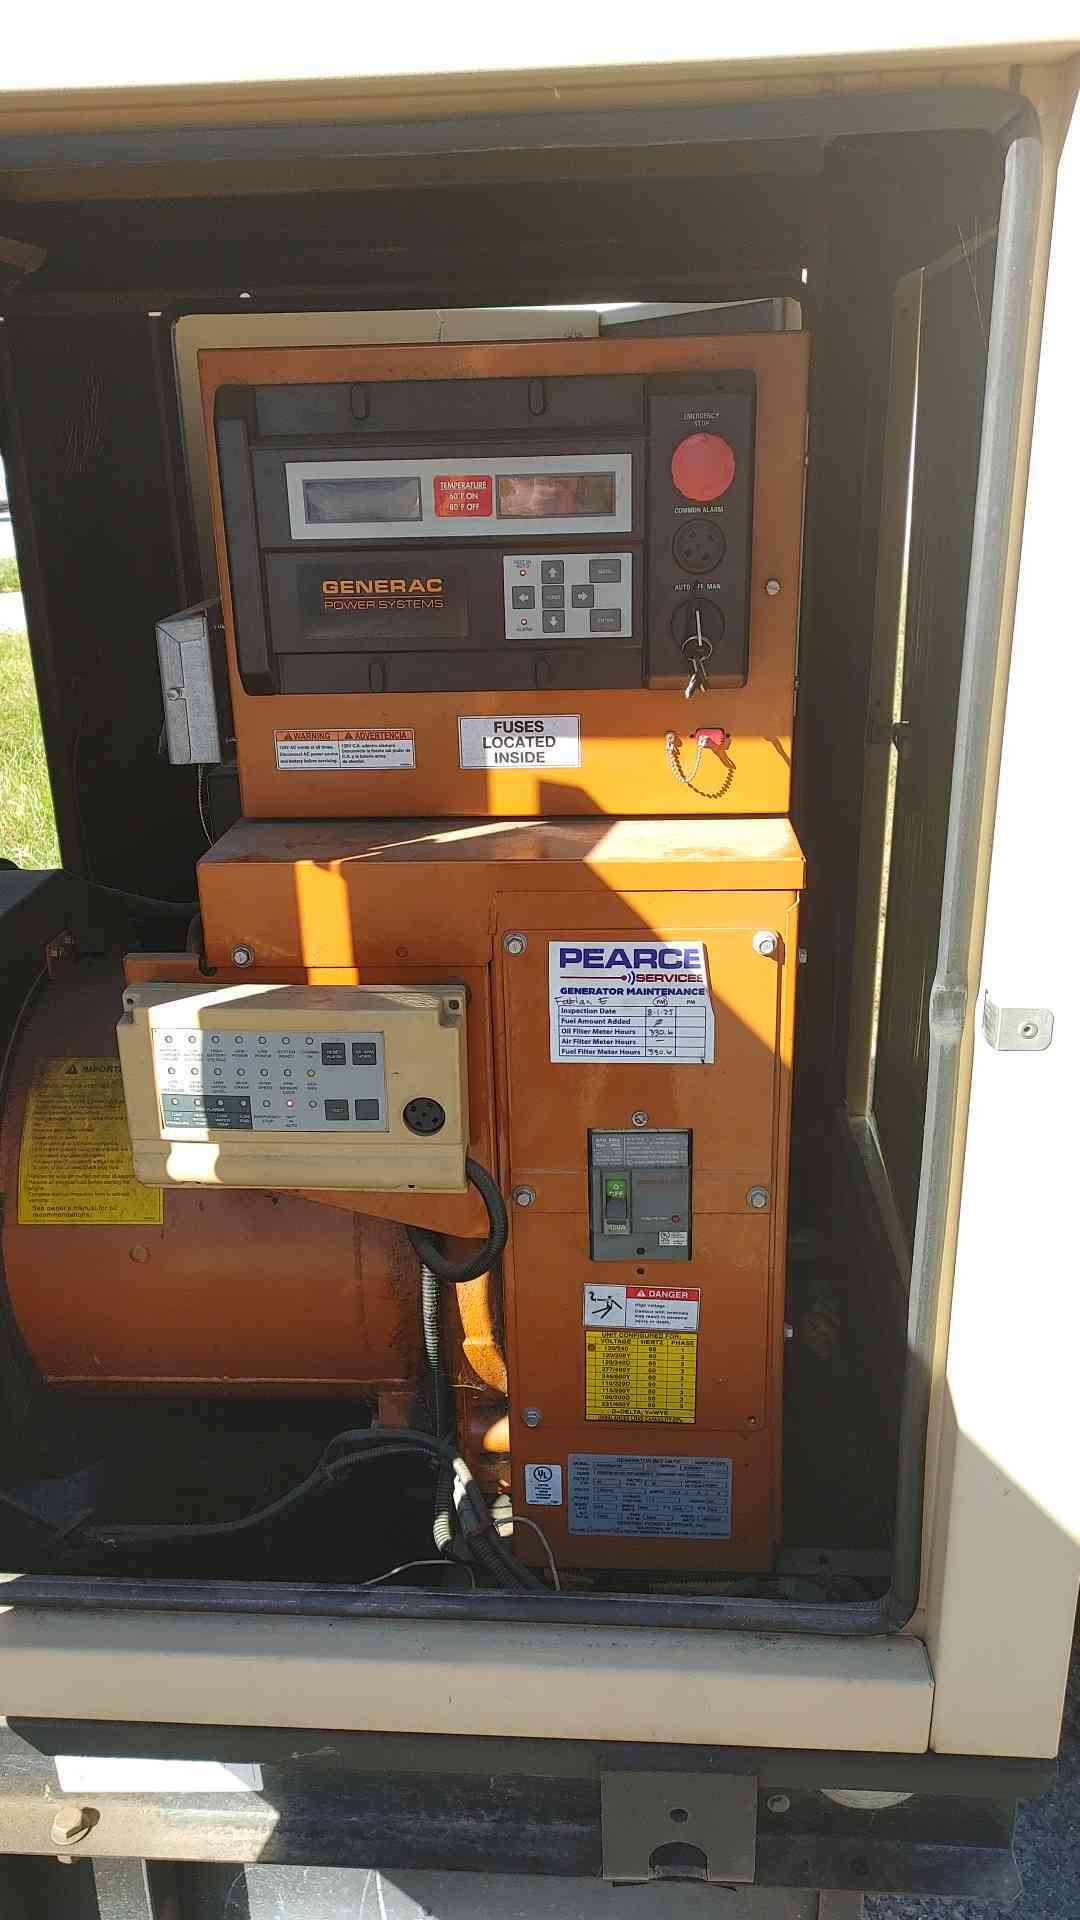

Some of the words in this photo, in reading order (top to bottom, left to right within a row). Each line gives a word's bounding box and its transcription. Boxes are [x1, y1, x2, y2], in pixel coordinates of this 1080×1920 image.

[440, 481, 487, 489] TEMPERATURE
[466, 492, 479, 500] ON
[703, 505, 724, 513] ALARM
[322, 578, 443, 593] GENERAC
[706, 583, 720, 591] MAN
[324, 600, 376, 609] POWER
[379, 599, 444, 609] SYSTEMS
[494, 720, 544, 733] FUSES
[294, 732, 331, 740] WARNING
[356, 731, 407, 740] ADVERTENCIA
[482, 736, 556, 749] LOCATED
[494, 751, 545, 763] INSIDE
[559, 947, 702, 970] PEARCE
[636, 974, 703, 983] SERVICES
[560, 987, 624, 996] GENERATOR
[627, 987, 705, 996] MAINTENANCE
[561, 1008, 599, 1016] Inspection
[648, 1290, 689, 1299] DANGER
